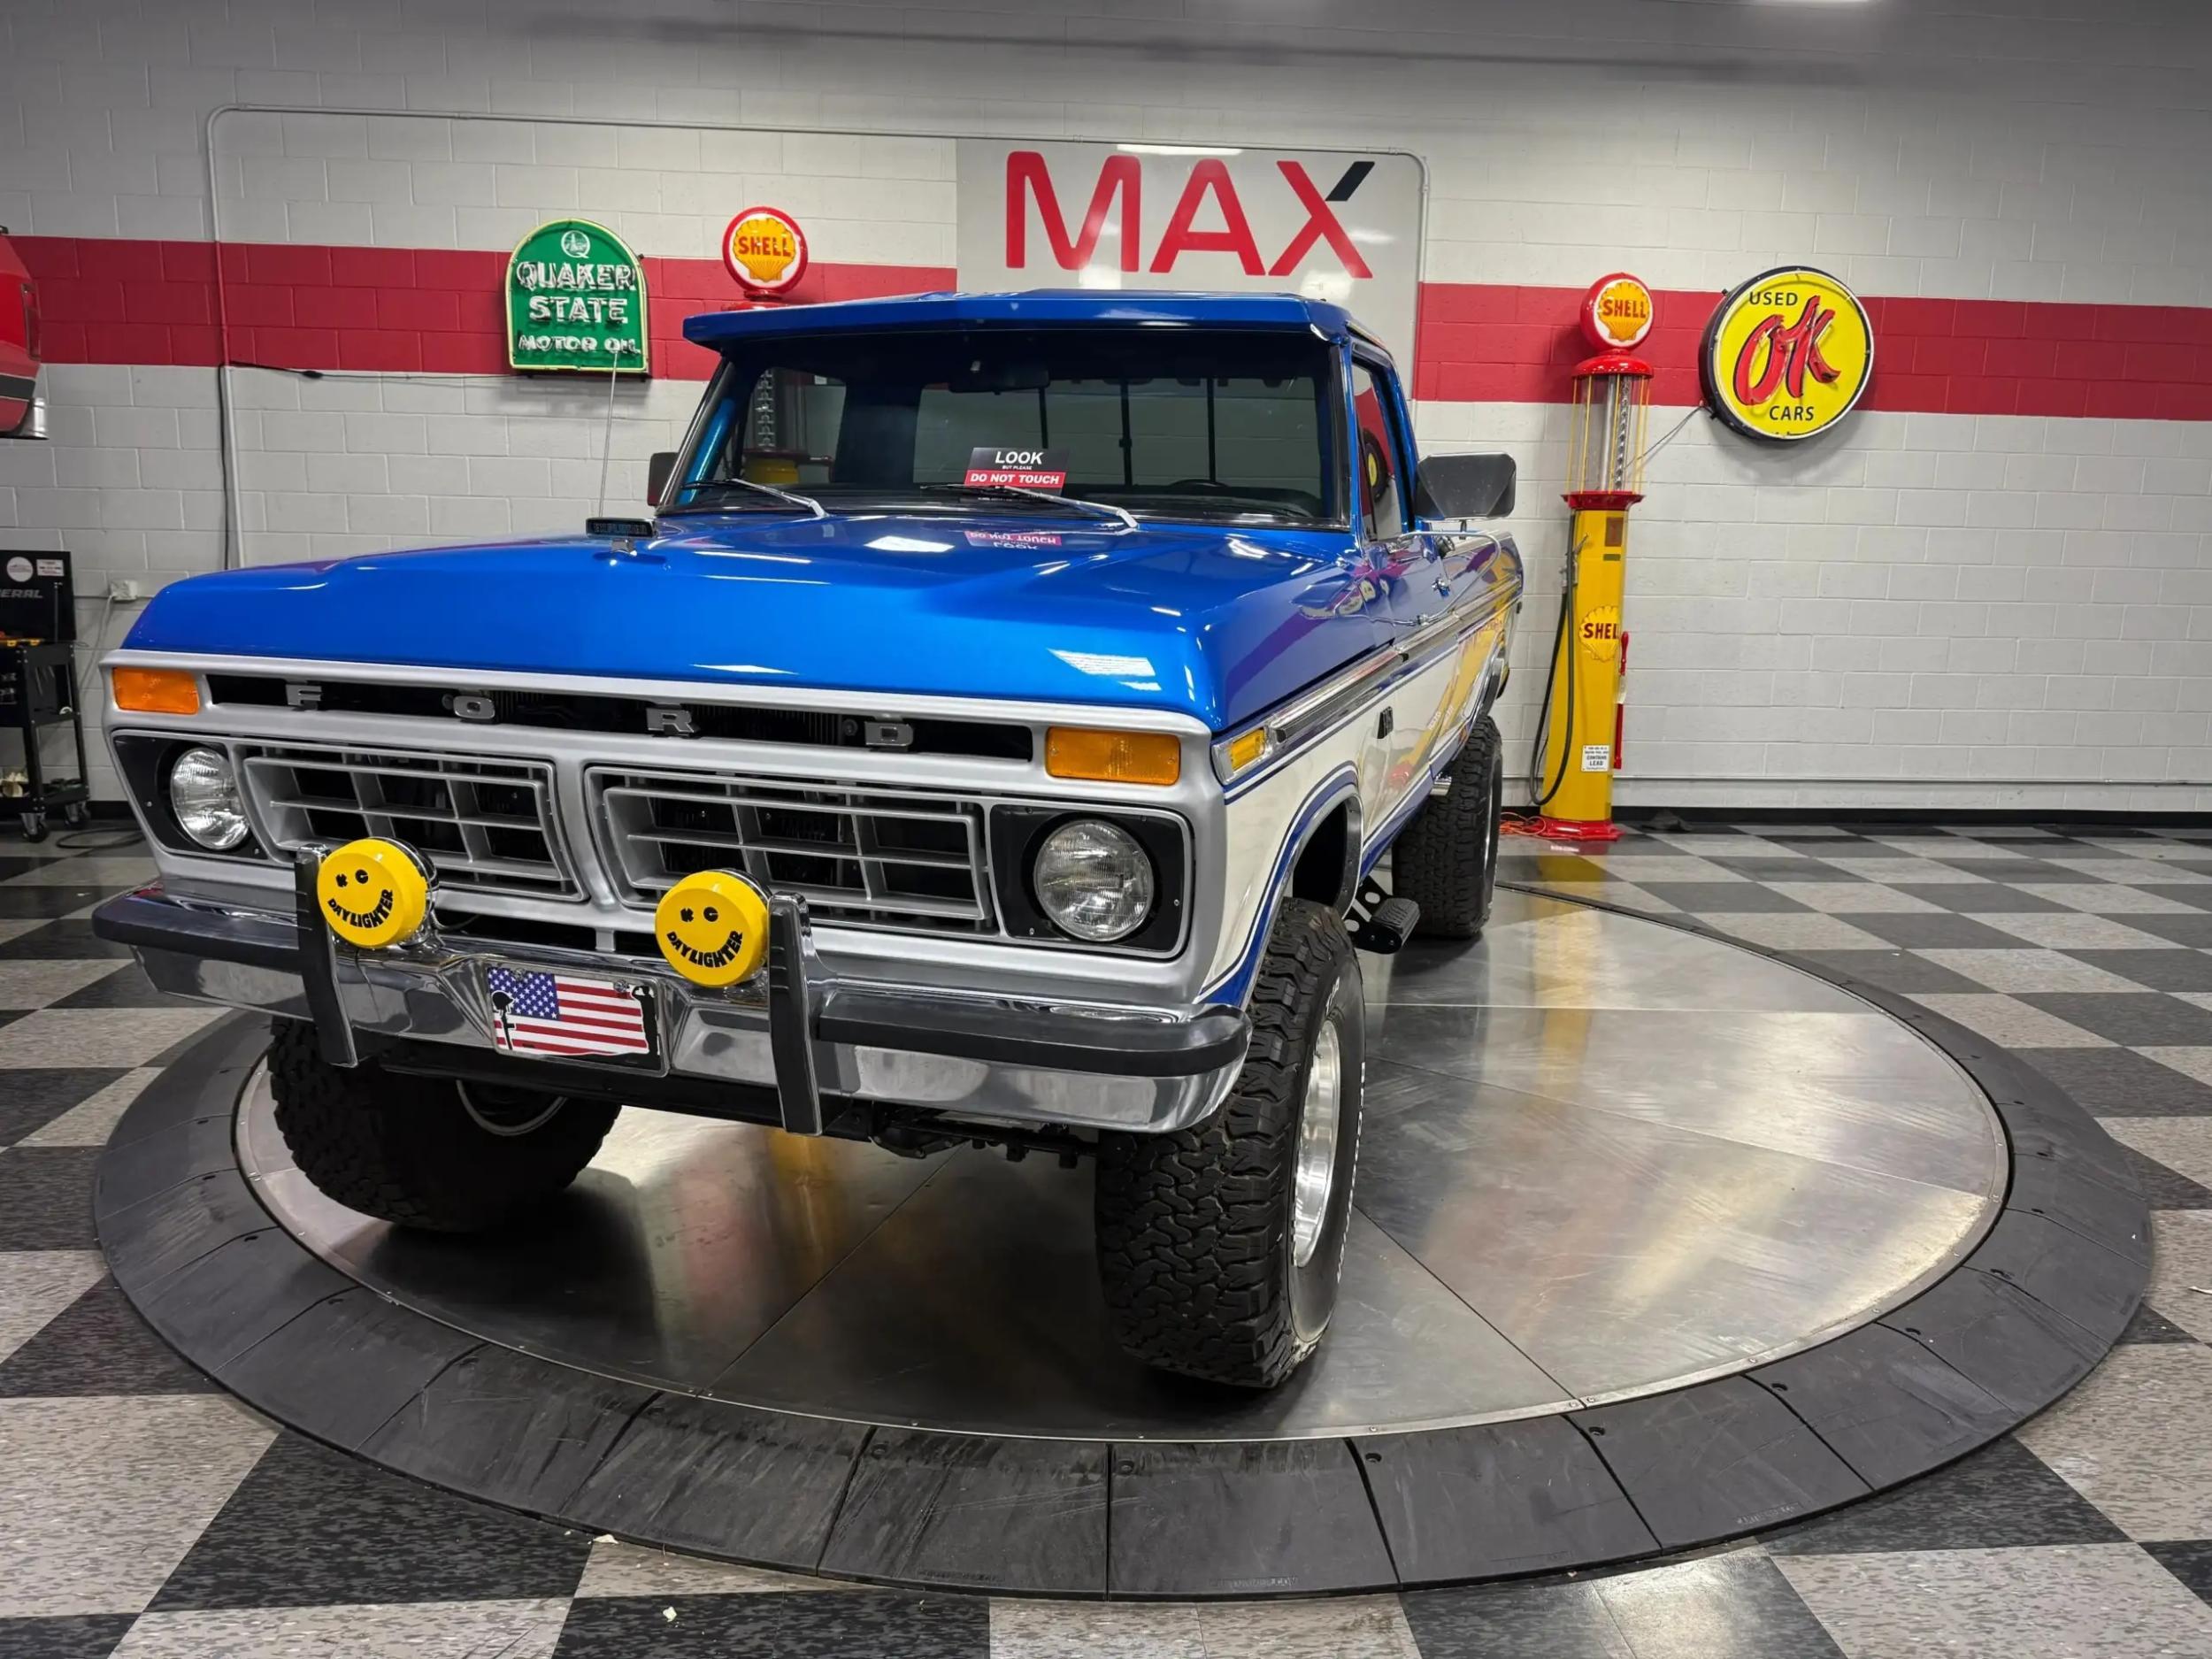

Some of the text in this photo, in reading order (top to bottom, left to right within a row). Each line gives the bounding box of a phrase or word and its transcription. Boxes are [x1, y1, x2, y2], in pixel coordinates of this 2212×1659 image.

[1006, 150, 1376, 279] MAX
[737, 234, 792, 258] SHELL
[516, 261, 636, 292] QUAKER
[1601, 298, 1647, 319] SHELL
[1748, 290, 1798, 306] USED
[528, 296, 628, 325] STATE
[518, 334, 641, 355] MOTOR OIL
[1732, 295, 1841, 406] OK
[1769, 404, 1814, 421] CARS
[995, 450, 1044, 465] LOOK
[970, 472, 1060, 485] DO NOT TOUCH
[0, 588, 43, 598] ERAL
[285, 684, 914, 747] FORD
[327, 888, 394, 929] DAYLIGHTER
[666, 930, 743, 968] DAYLIGHTER
